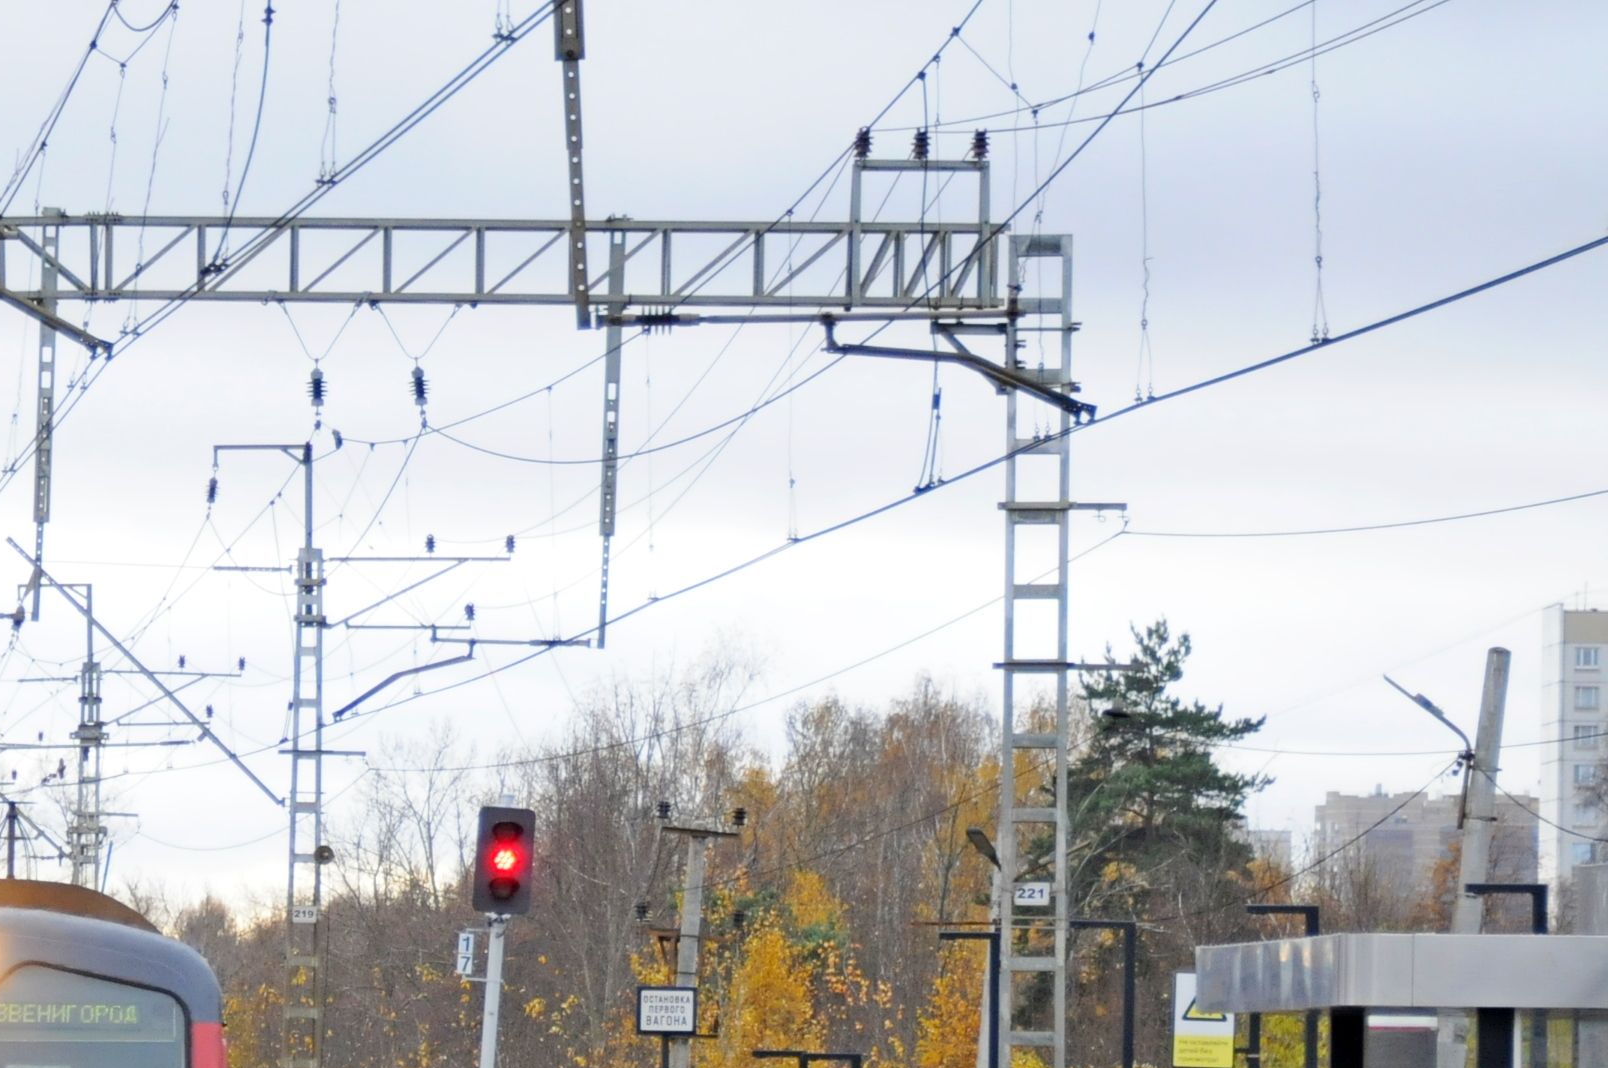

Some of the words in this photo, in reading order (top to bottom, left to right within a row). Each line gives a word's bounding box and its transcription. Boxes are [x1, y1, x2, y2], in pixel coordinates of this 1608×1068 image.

[1017, 887, 1044, 899] 221
[294, 910, 314, 919] 219
[643, 995, 691, 1004] ОСТАНОВКА
[648, 1005, 686, 1014] ПЕРВОГО
[646, 1015, 688, 1026] ВАГОНА
